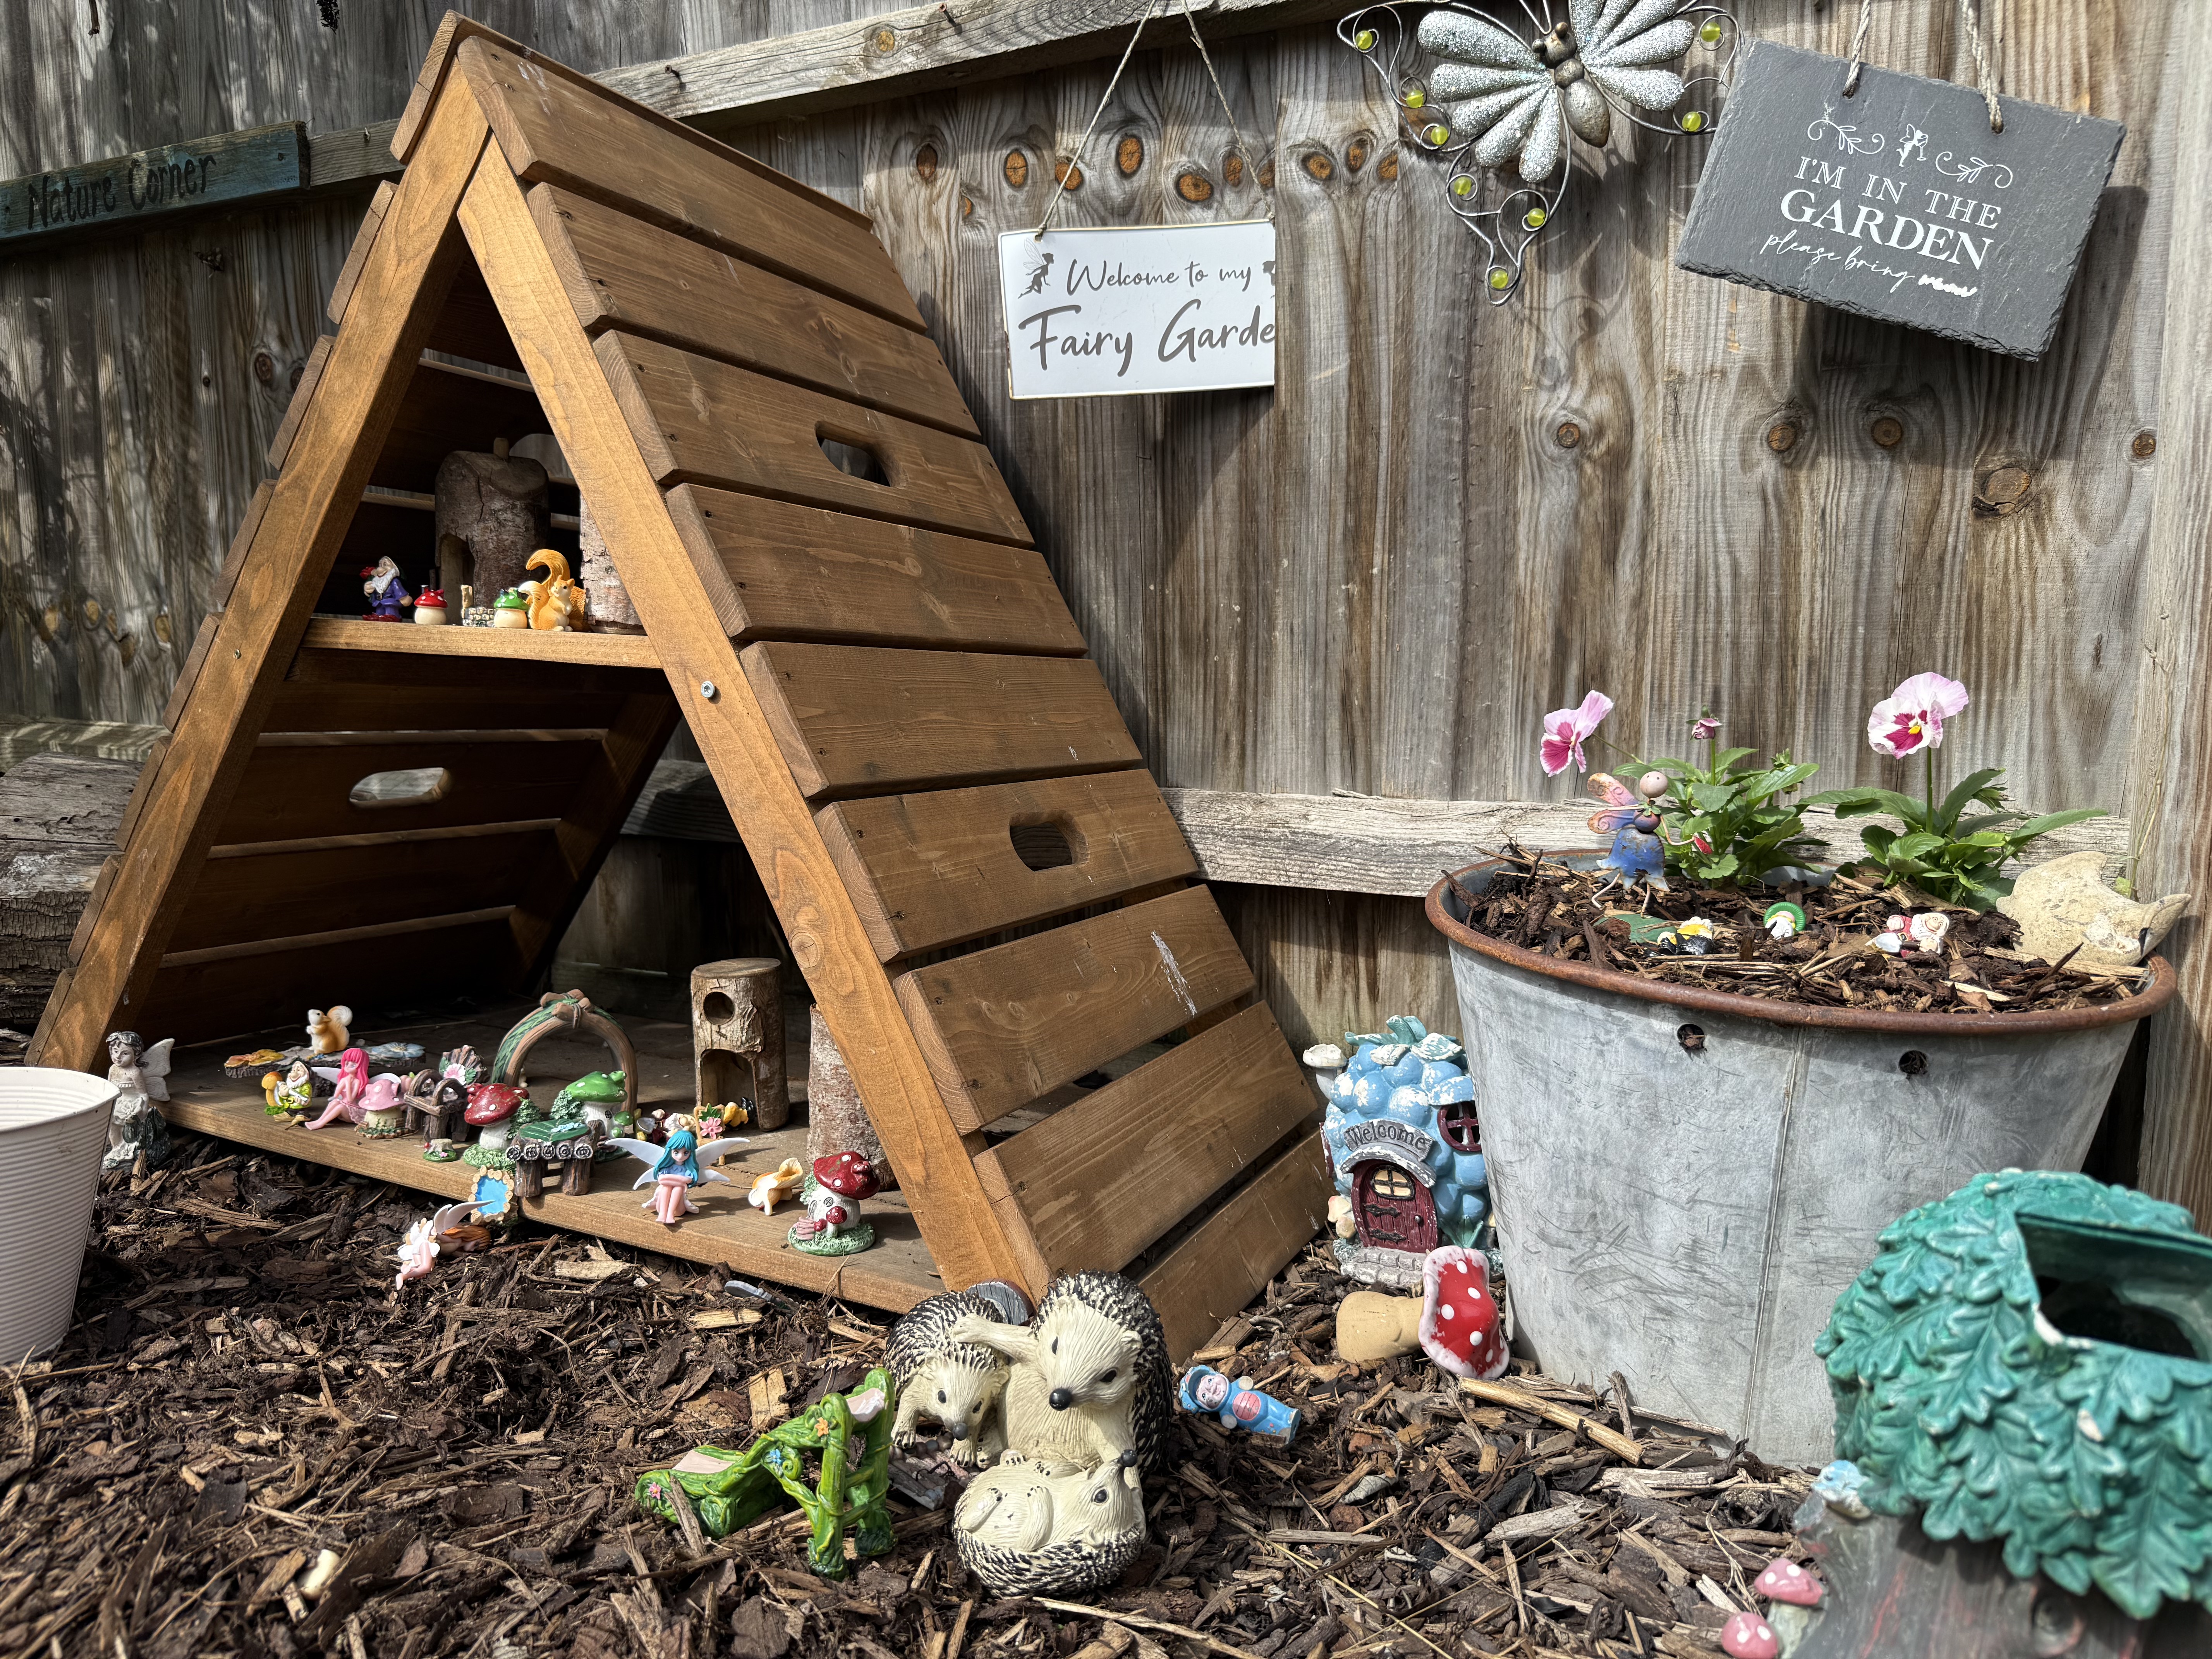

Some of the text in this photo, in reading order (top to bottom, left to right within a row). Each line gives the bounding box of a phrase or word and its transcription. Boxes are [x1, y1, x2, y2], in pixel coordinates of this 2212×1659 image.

[27, 156, 216, 230] Nature Corner
[1781, 189, 1994, 270] GARDEN
[1794, 156, 2002, 230] I'M IN THE
[1066, 259, 1251, 296] Welcome to my
[1759, 229, 1841, 264] please
[1845, 246, 1915, 293] bring
[1018, 299, 1275, 378] Fairy Garde
[1346, 1121, 1426, 1150] Welcome
